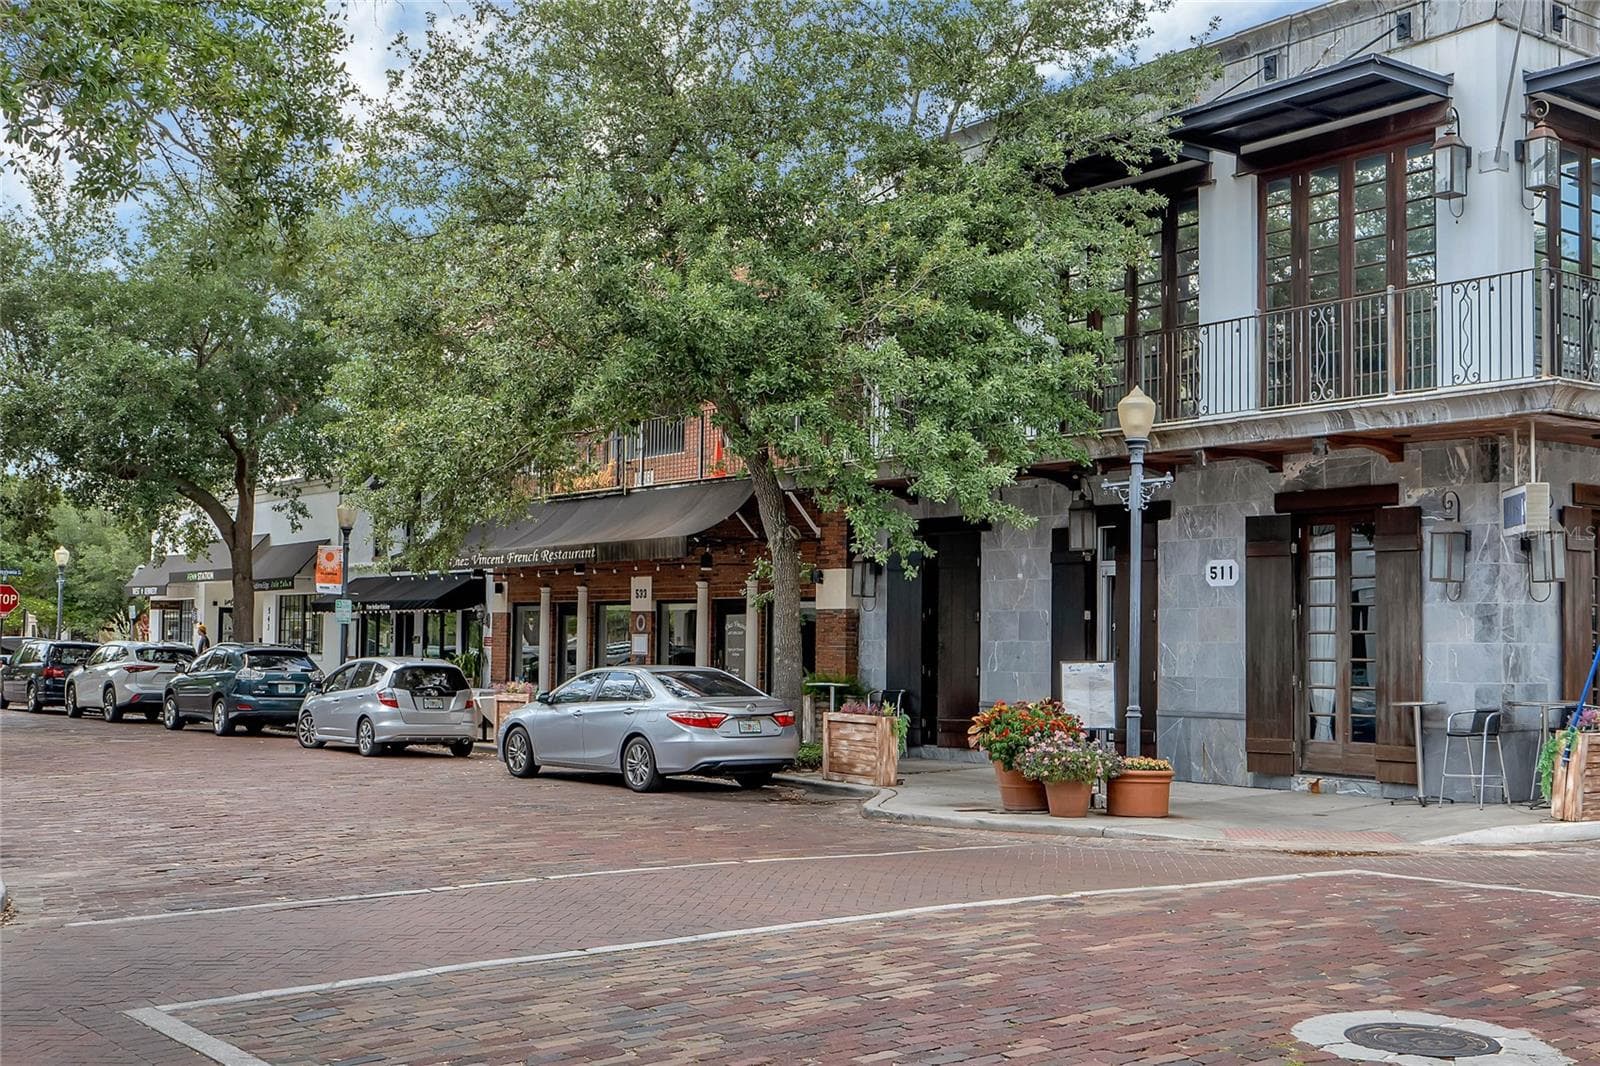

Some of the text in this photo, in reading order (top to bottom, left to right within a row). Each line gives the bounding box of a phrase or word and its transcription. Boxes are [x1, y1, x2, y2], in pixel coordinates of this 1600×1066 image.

[471, 552, 504, 565] Vincent
[507, 549, 539, 563] French
[540, 547, 596, 562] Restaurant
[1210, 565, 1233, 580] 511
